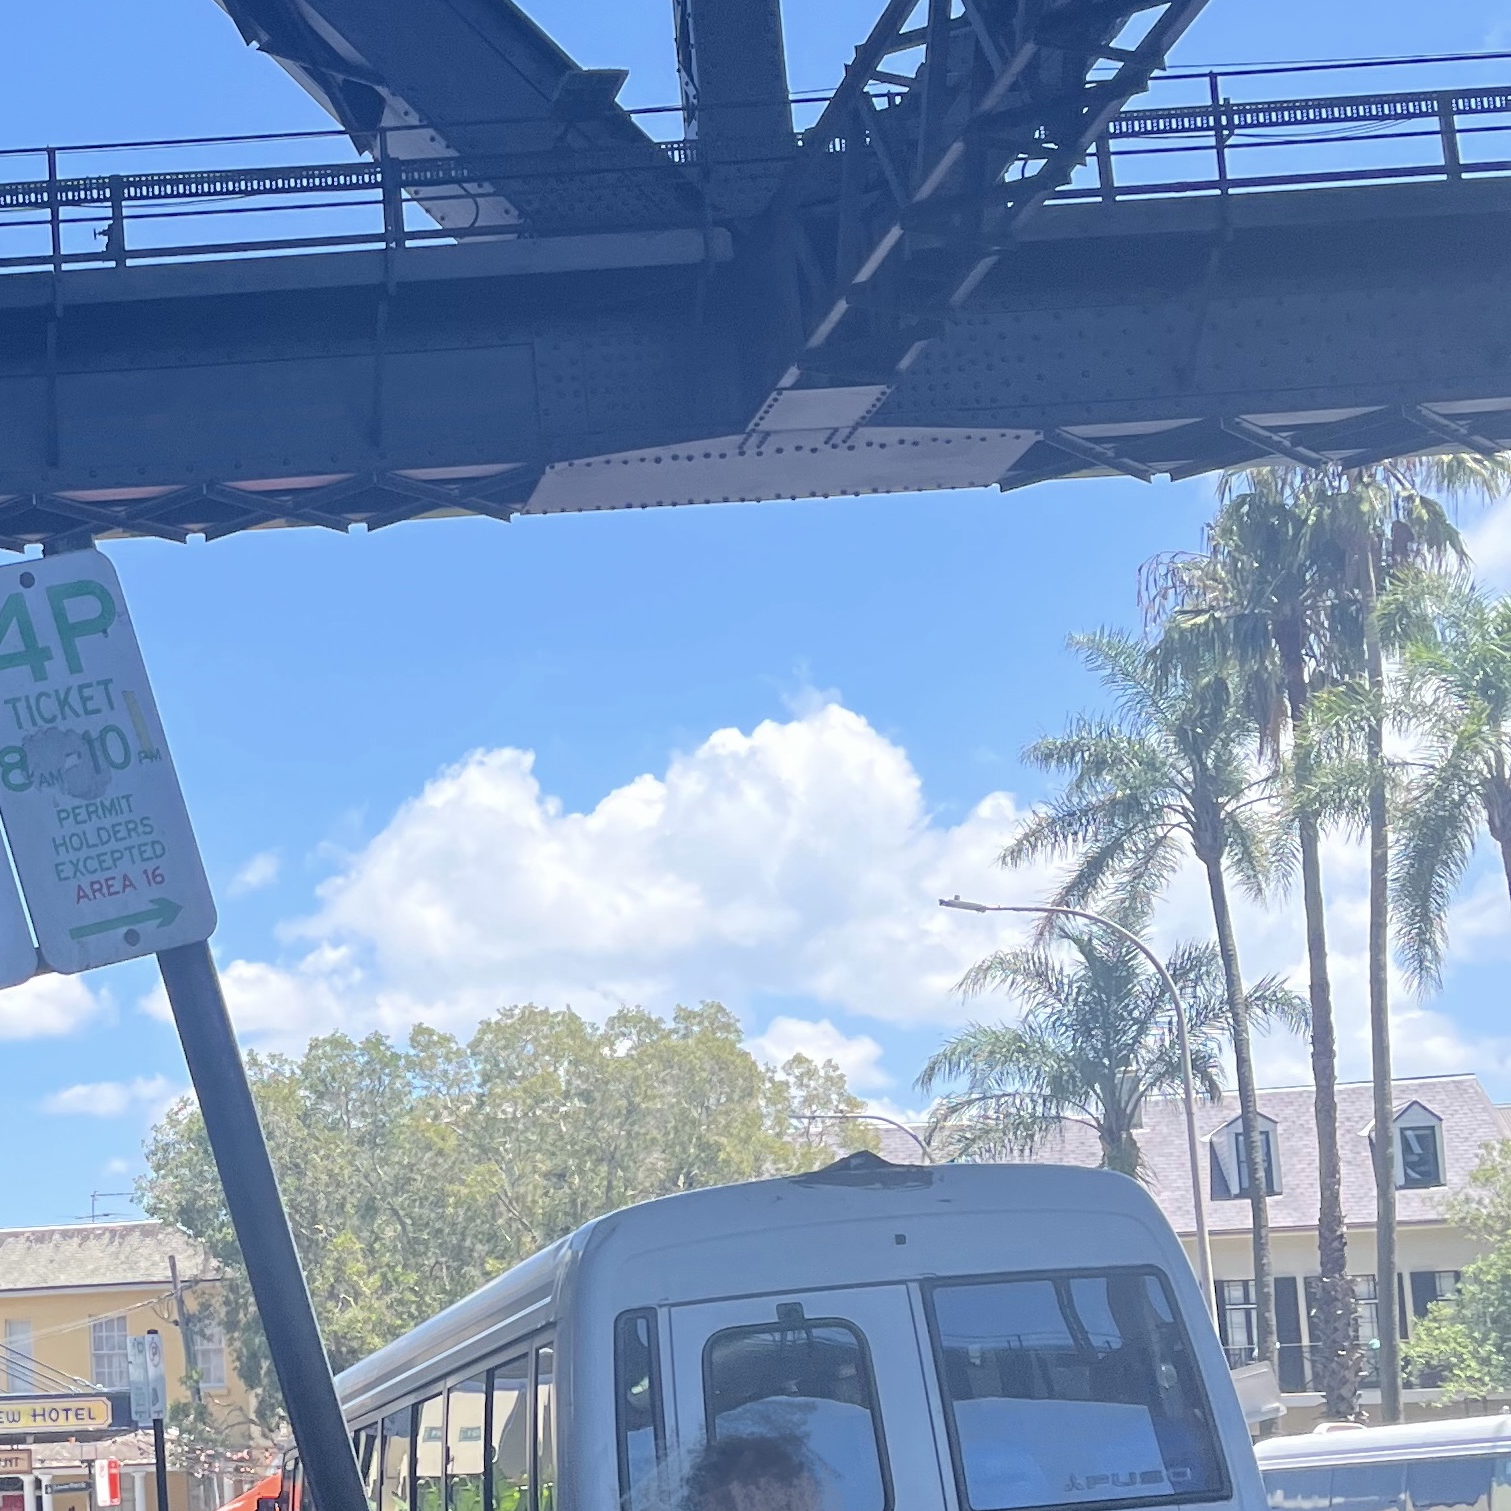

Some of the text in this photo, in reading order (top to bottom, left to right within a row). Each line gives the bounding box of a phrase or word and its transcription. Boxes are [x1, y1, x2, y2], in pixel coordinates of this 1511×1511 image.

[4, 678, 115, 730] TICKET
[56, 794, 133, 829] PERMIT
[52, 816, 154, 856] HOLDERS
[54, 840, 166, 882] EXCEPTED
[76, 866, 165, 905] AREA 16
[31, 1407, 97, 1423] HOTEL
